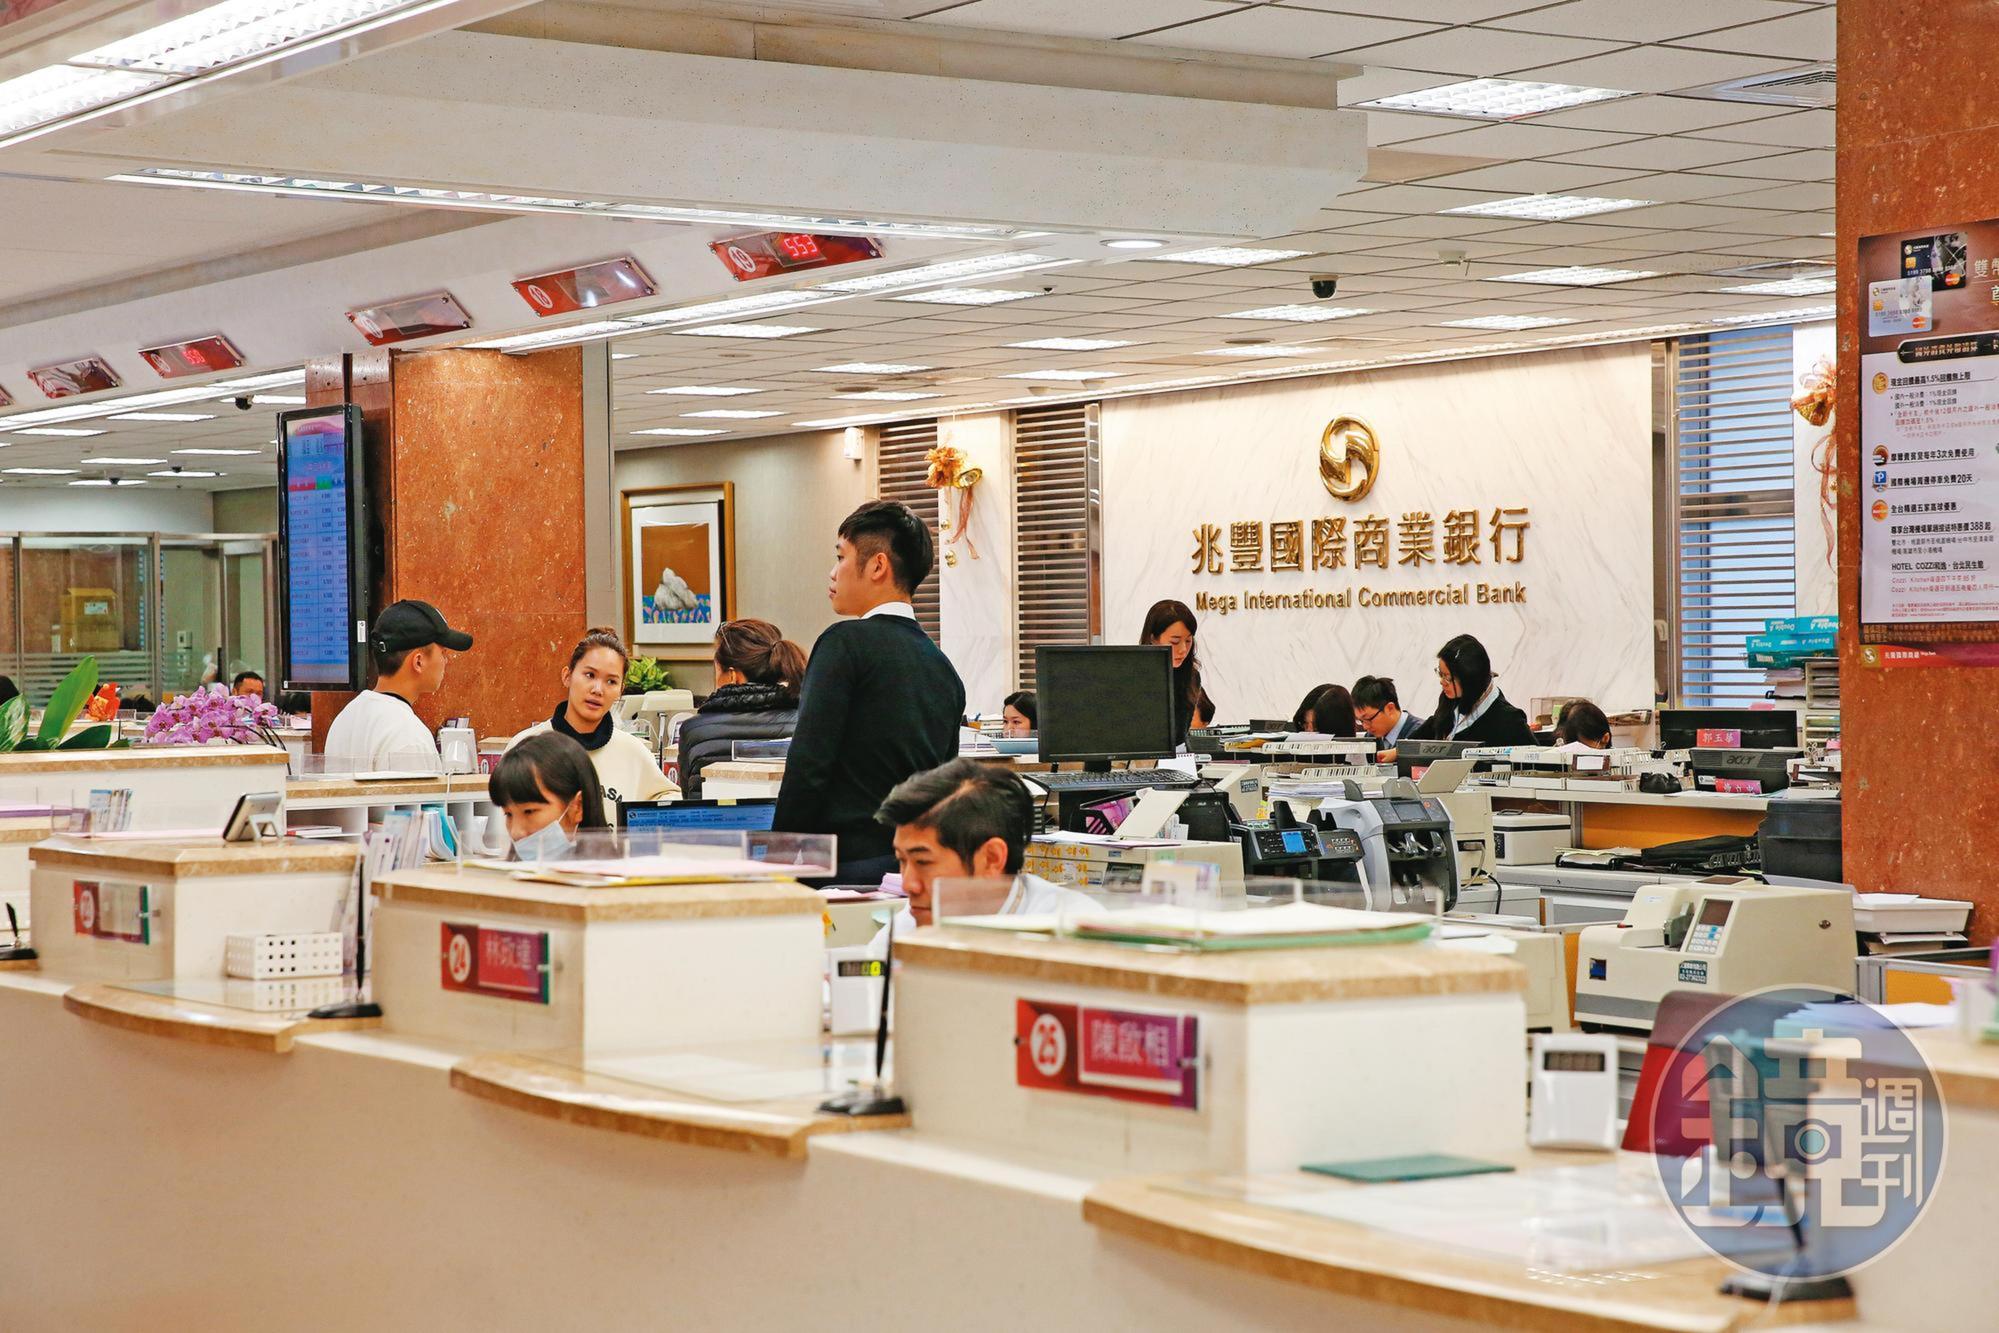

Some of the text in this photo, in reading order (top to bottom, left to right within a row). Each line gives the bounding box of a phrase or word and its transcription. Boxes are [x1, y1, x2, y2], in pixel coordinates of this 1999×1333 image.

[783, 234, 818, 257] 553
[1191, 507, 1531, 574] 兆豐國際商業銀行
[1891, 562, 1913, 570] HOTEL
[1195, 581, 1527, 616] Mega International Commercial Bank
[1726, 754, 1758, 766] acer
[453, 942, 467, 974] 24
